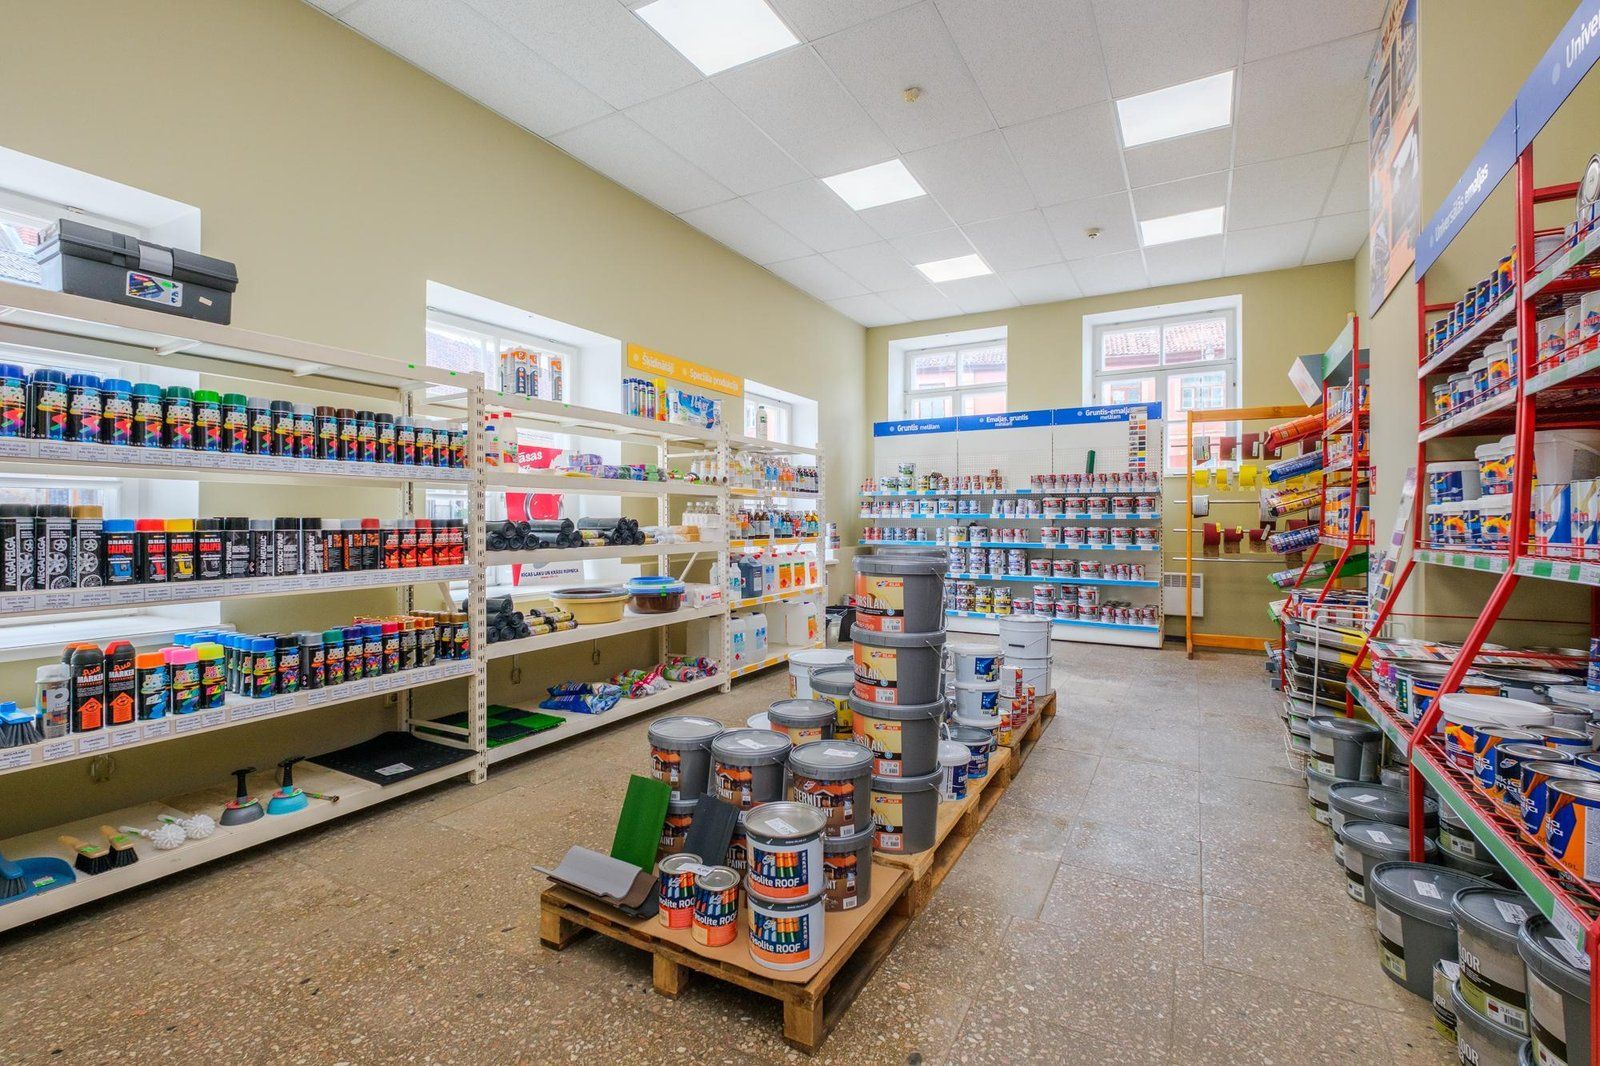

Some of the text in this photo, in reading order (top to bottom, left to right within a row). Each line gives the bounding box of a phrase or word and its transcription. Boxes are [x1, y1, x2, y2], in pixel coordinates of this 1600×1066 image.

[1566, 9, 1600, 68] Unive
[1085, 407, 1130, 416] Gruntis-emalj
[1009, 414, 1028, 423] gruntis
[897, 424, 918, 432] Gruntis
[518, 452, 543, 462] āsas
[4, 536, 16, 587] MEGAFELGA
[37, 536, 46, 585] MEGAFELGA
[774, 877, 800, 888] ROOF
[775, 943, 801, 953] ROOF
